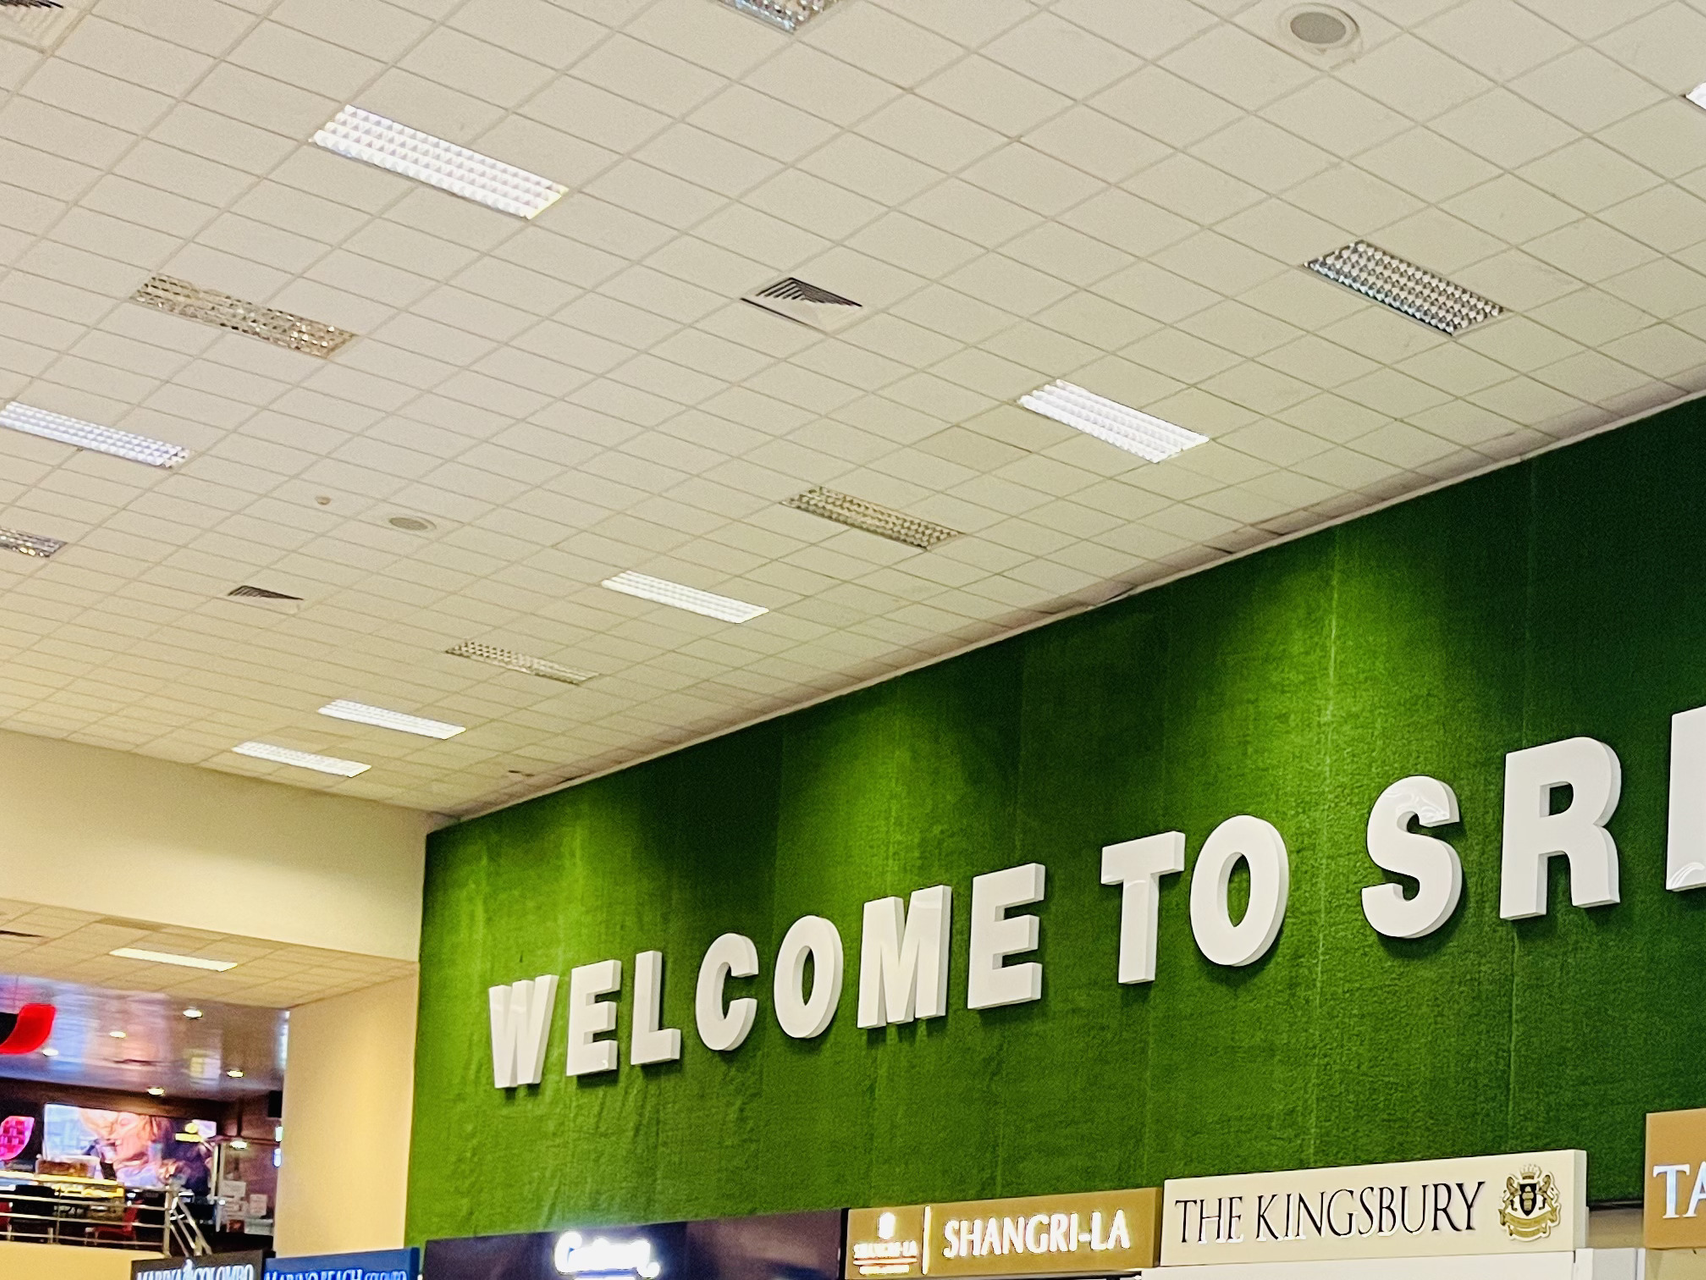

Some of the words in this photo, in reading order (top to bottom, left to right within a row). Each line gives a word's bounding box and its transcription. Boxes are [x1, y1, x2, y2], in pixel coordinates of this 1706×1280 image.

[489, 862, 1045, 1088] WELCOME
[1101, 814, 1289, 968] TO
[942, 1209, 1131, 1258] SHANGRI-LA
[1174, 1195, 1245, 1244] THE
[1254, 1180, 1486, 1242] KINGSBURY
